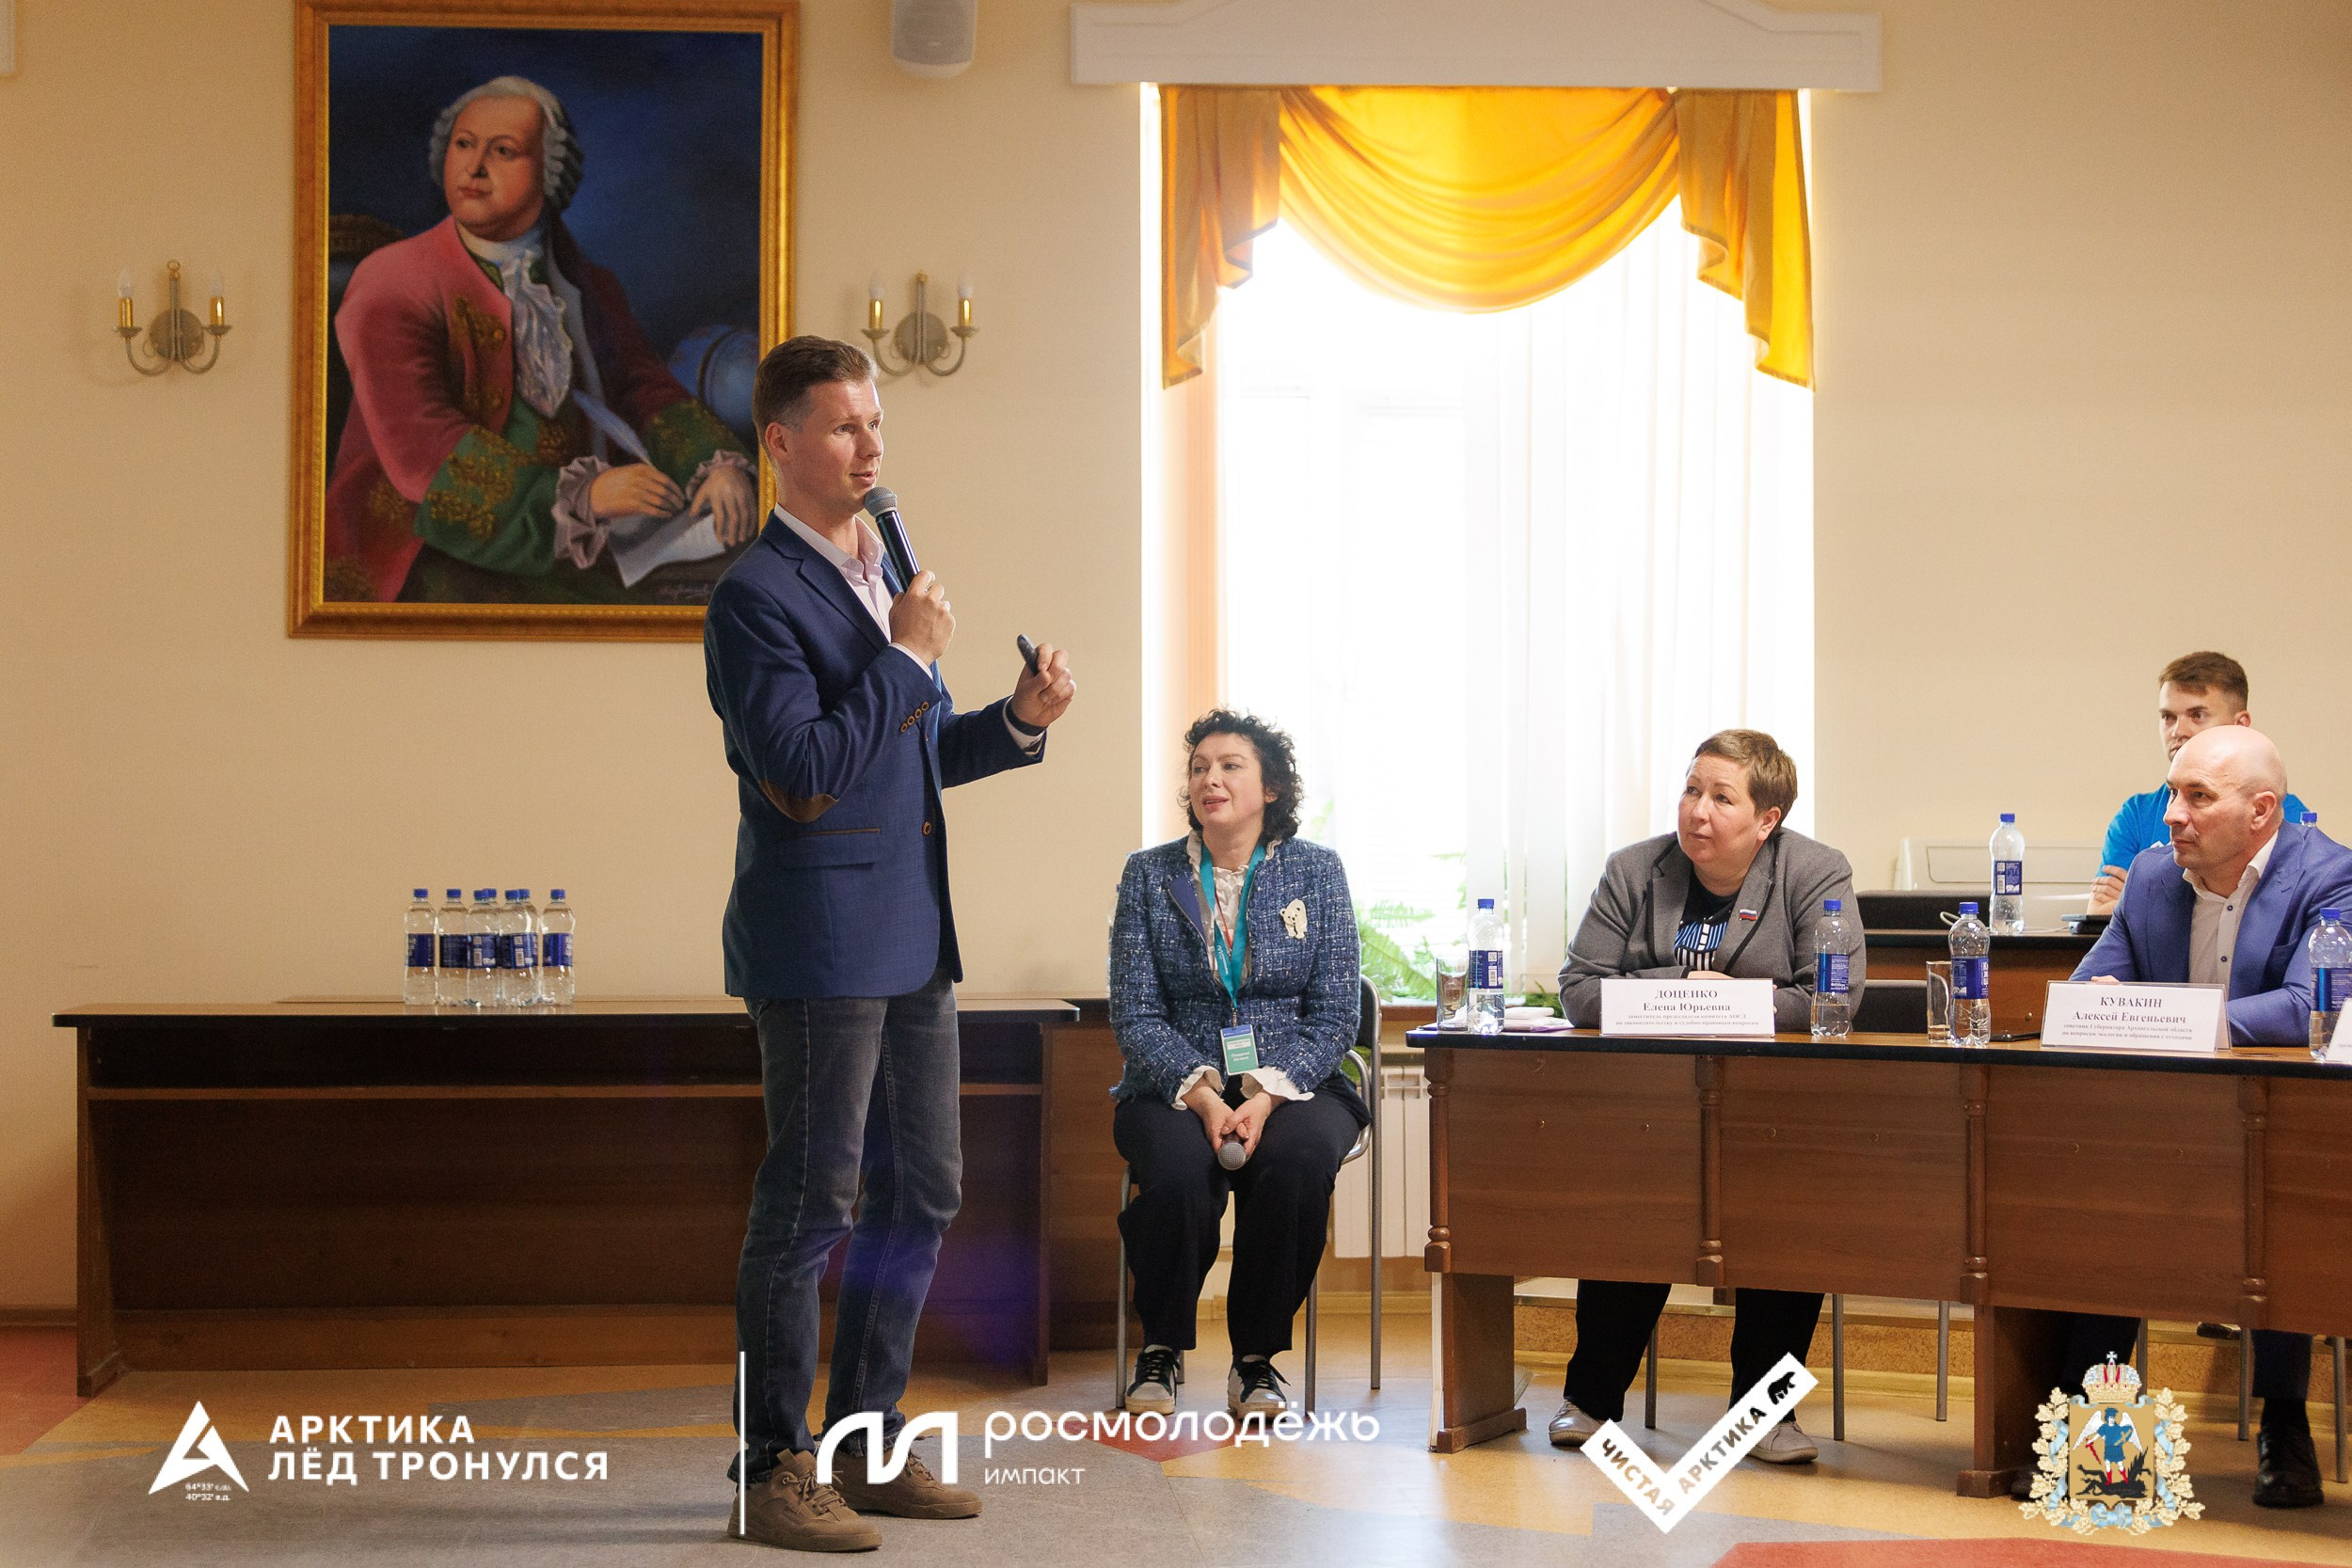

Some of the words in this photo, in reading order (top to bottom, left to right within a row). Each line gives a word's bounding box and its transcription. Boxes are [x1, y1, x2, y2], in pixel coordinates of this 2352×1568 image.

[1654, 990, 1718, 1000] ДОЦЕНКО
[2100, 996, 2162, 1008] КУВАКИН
[1643, 1003, 1677, 1011] Елена
[1679, 1003, 1731, 1014] Юрьевна
[2073, 1010, 2118, 1022] Алексей
[2122, 1011, 2186, 1024] Евгеньевич
